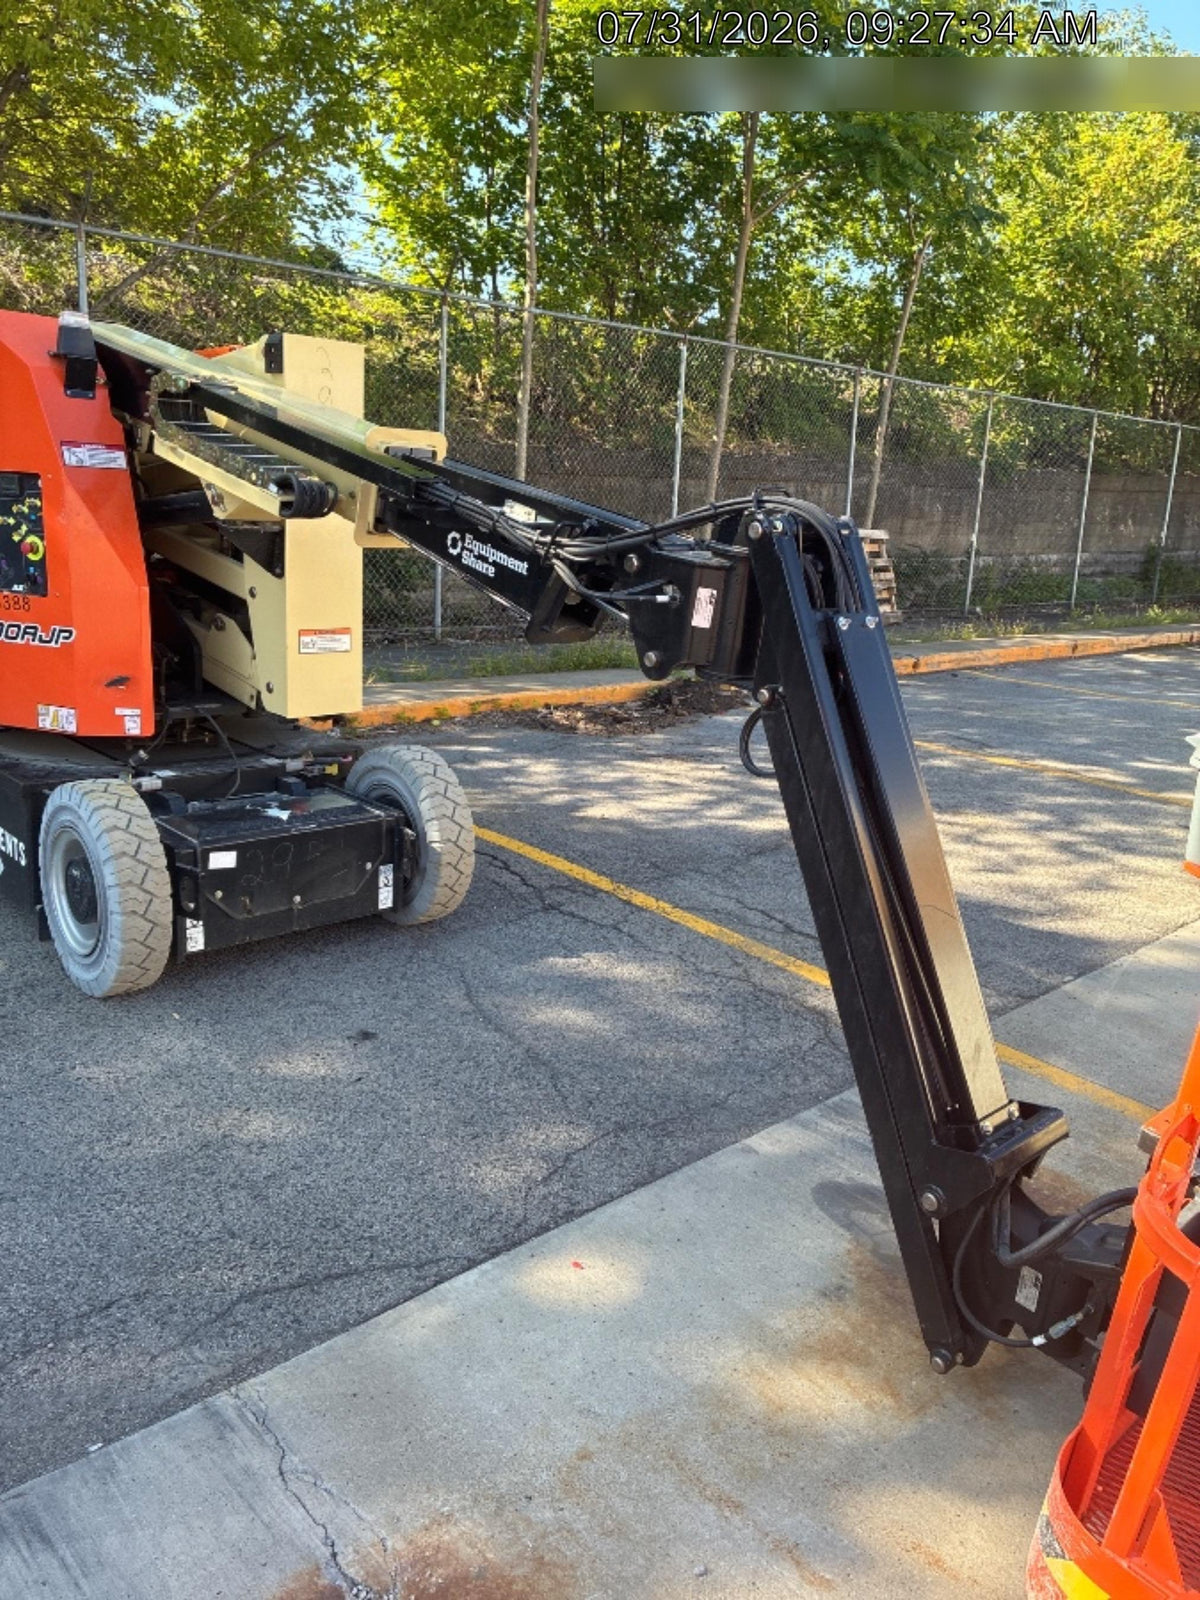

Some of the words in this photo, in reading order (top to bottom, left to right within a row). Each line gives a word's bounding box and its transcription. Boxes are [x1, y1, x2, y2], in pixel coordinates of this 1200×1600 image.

[461, 549, 495, 577] Share
[464, 533, 528, 575] Equipment
[0, 595, 31, 612] 388
